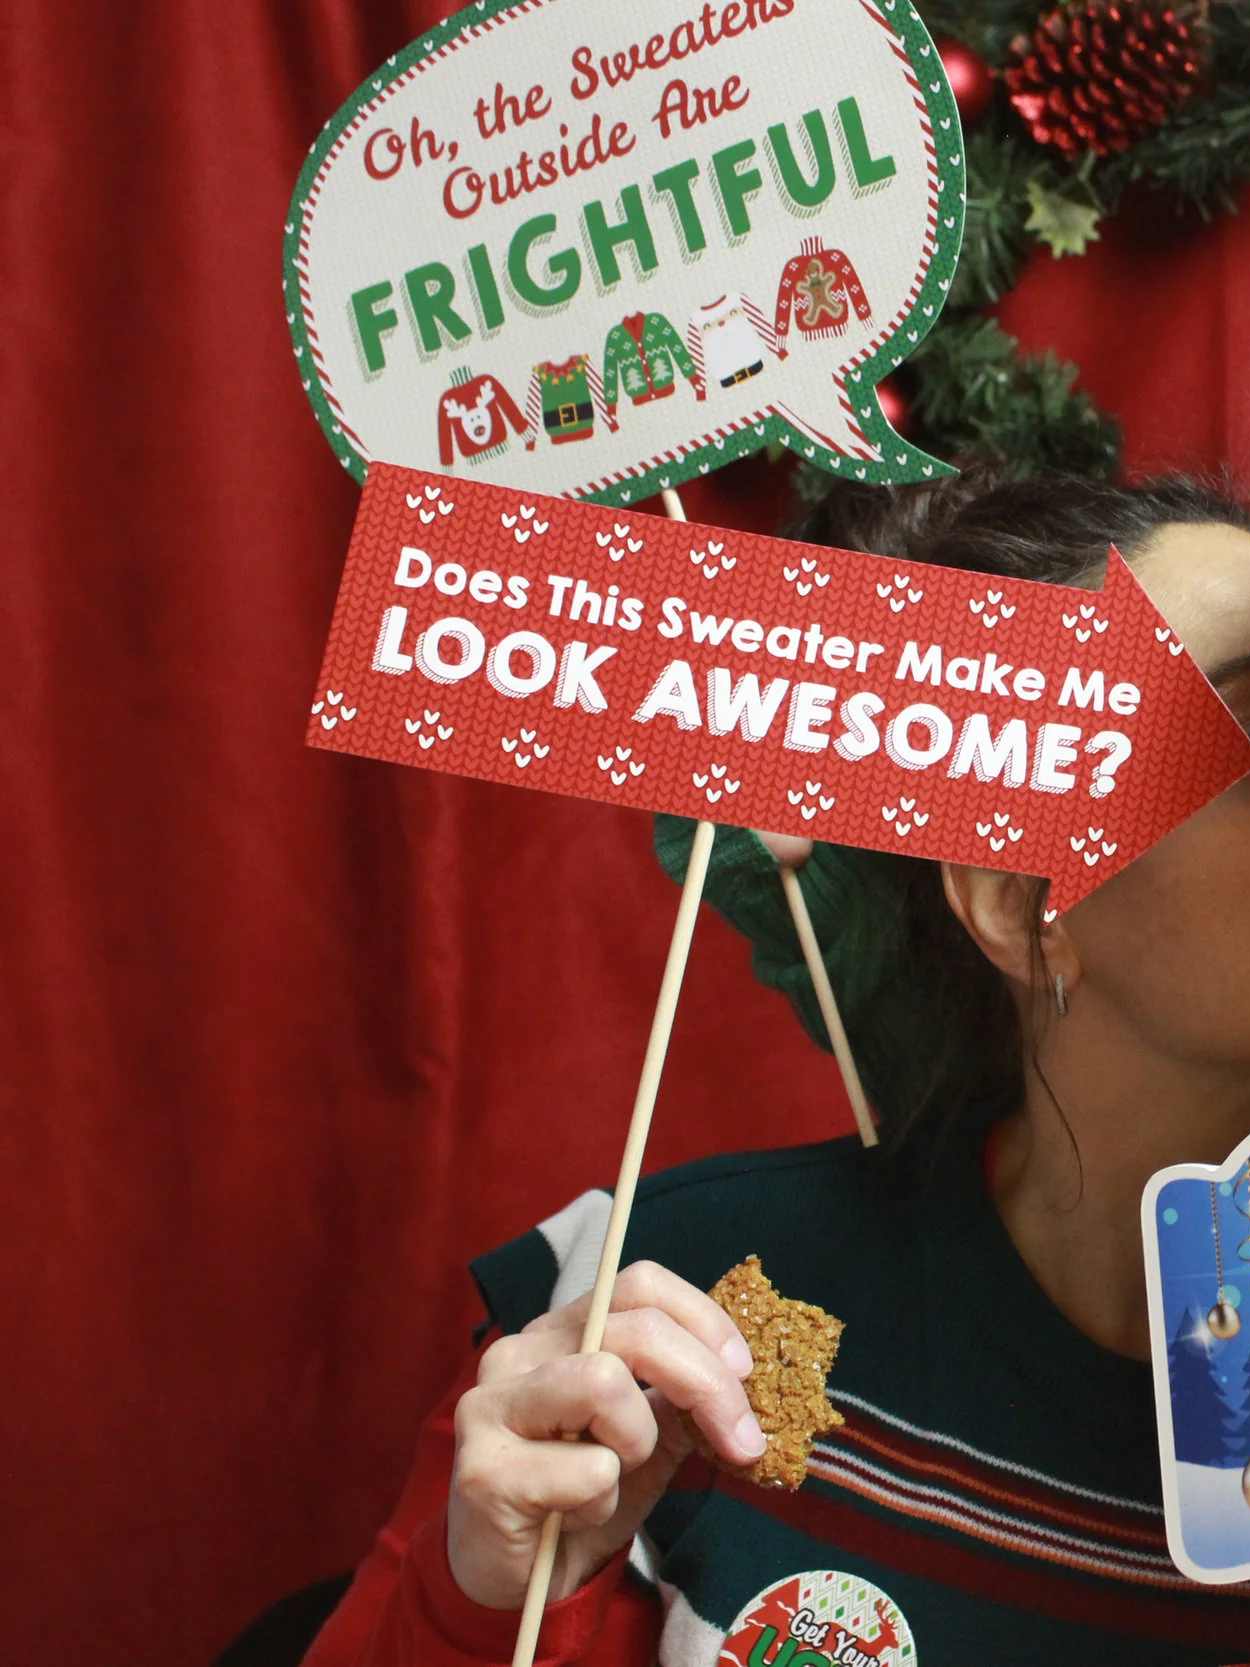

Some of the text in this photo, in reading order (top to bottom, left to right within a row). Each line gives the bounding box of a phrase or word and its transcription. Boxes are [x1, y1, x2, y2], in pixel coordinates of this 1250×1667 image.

[362, 0, 796, 182] Oh, the Sweaters
[442, 75, 750, 220] Outside Are
[348, 96, 898, 380] FRIGHTFUL
[370, 605, 1133, 799] LOOK AWESOME?
[393, 546, 1142, 716] Does This Sweater Make Me
[789, 1608, 829, 1649] Get
